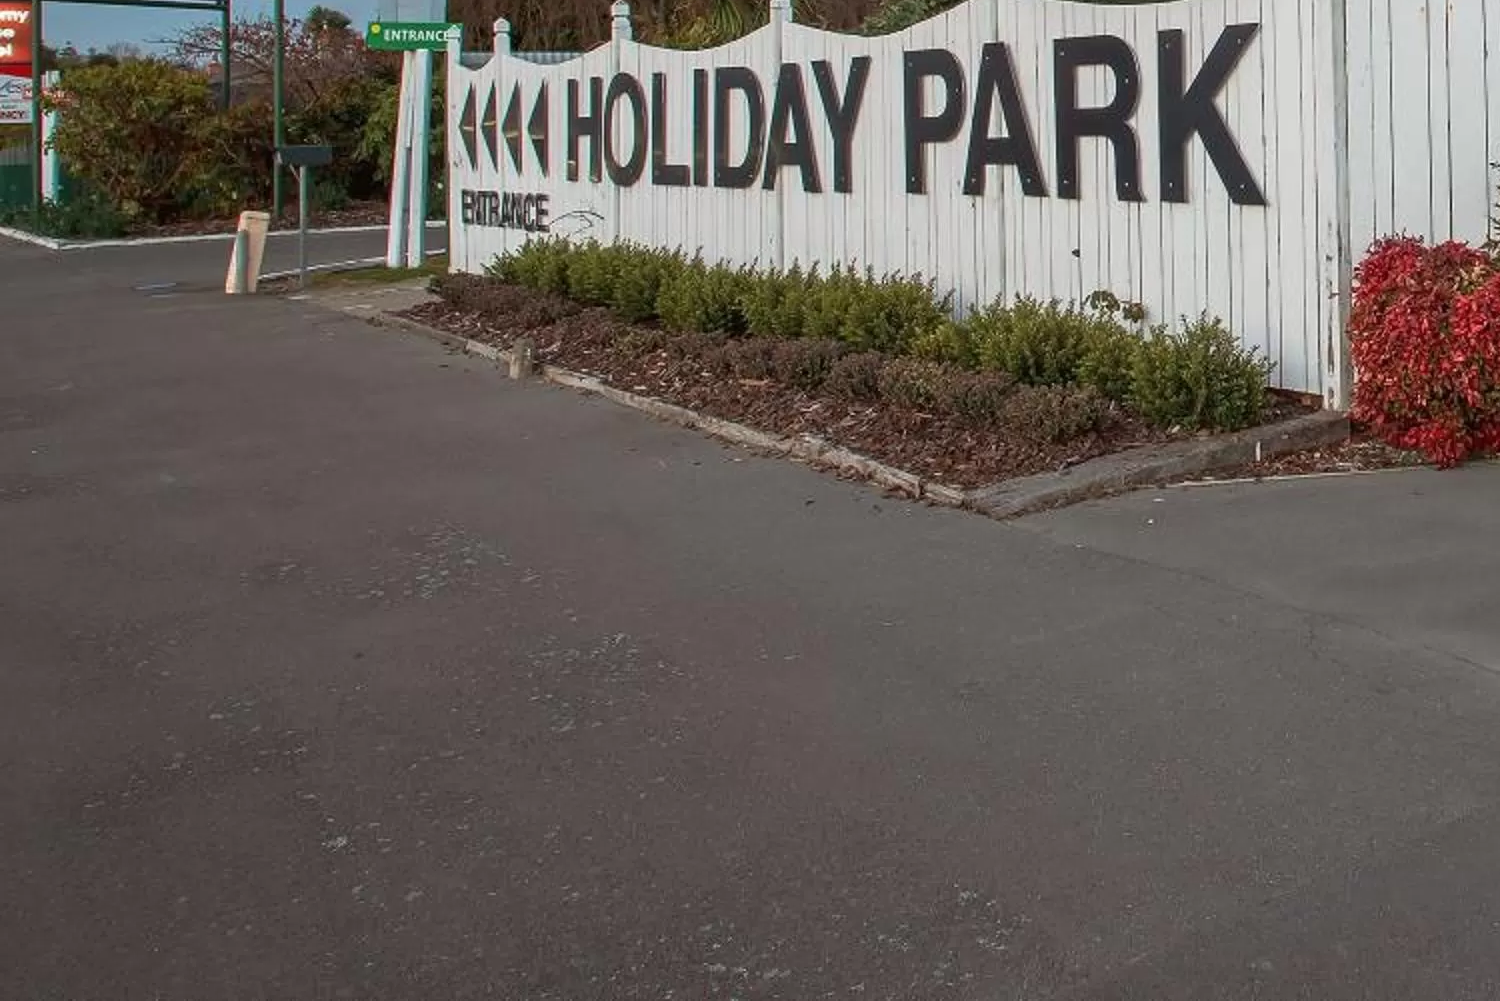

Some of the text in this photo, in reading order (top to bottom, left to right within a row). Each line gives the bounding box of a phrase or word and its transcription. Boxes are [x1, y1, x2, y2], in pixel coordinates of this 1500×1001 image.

[566, 22, 1270, 207] HOLIDAY PARK
[461, 188, 551, 233] ENTRANCE
